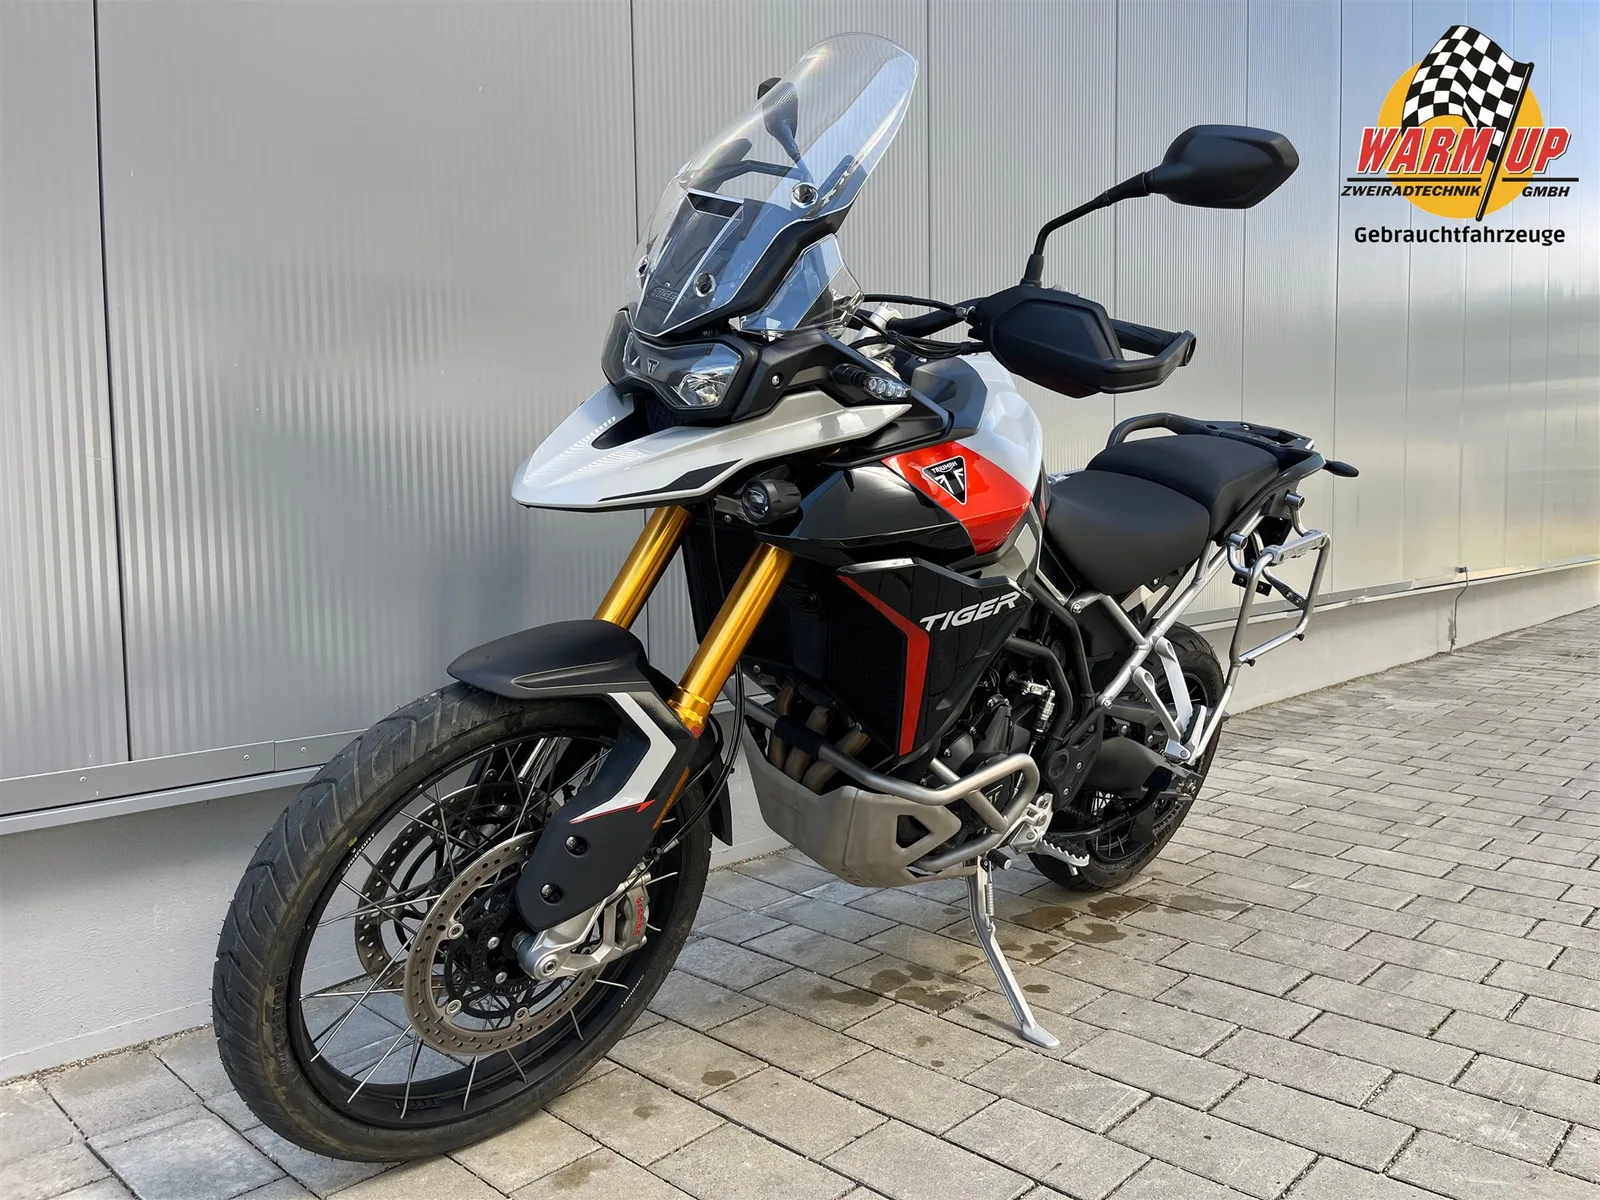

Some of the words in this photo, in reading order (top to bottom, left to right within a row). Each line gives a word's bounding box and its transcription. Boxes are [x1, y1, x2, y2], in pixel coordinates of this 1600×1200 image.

[931, 460, 958, 473] TRIUMPH
[920, 590, 1020, 632] TIGER
[633, 895, 644, 937] brembo
